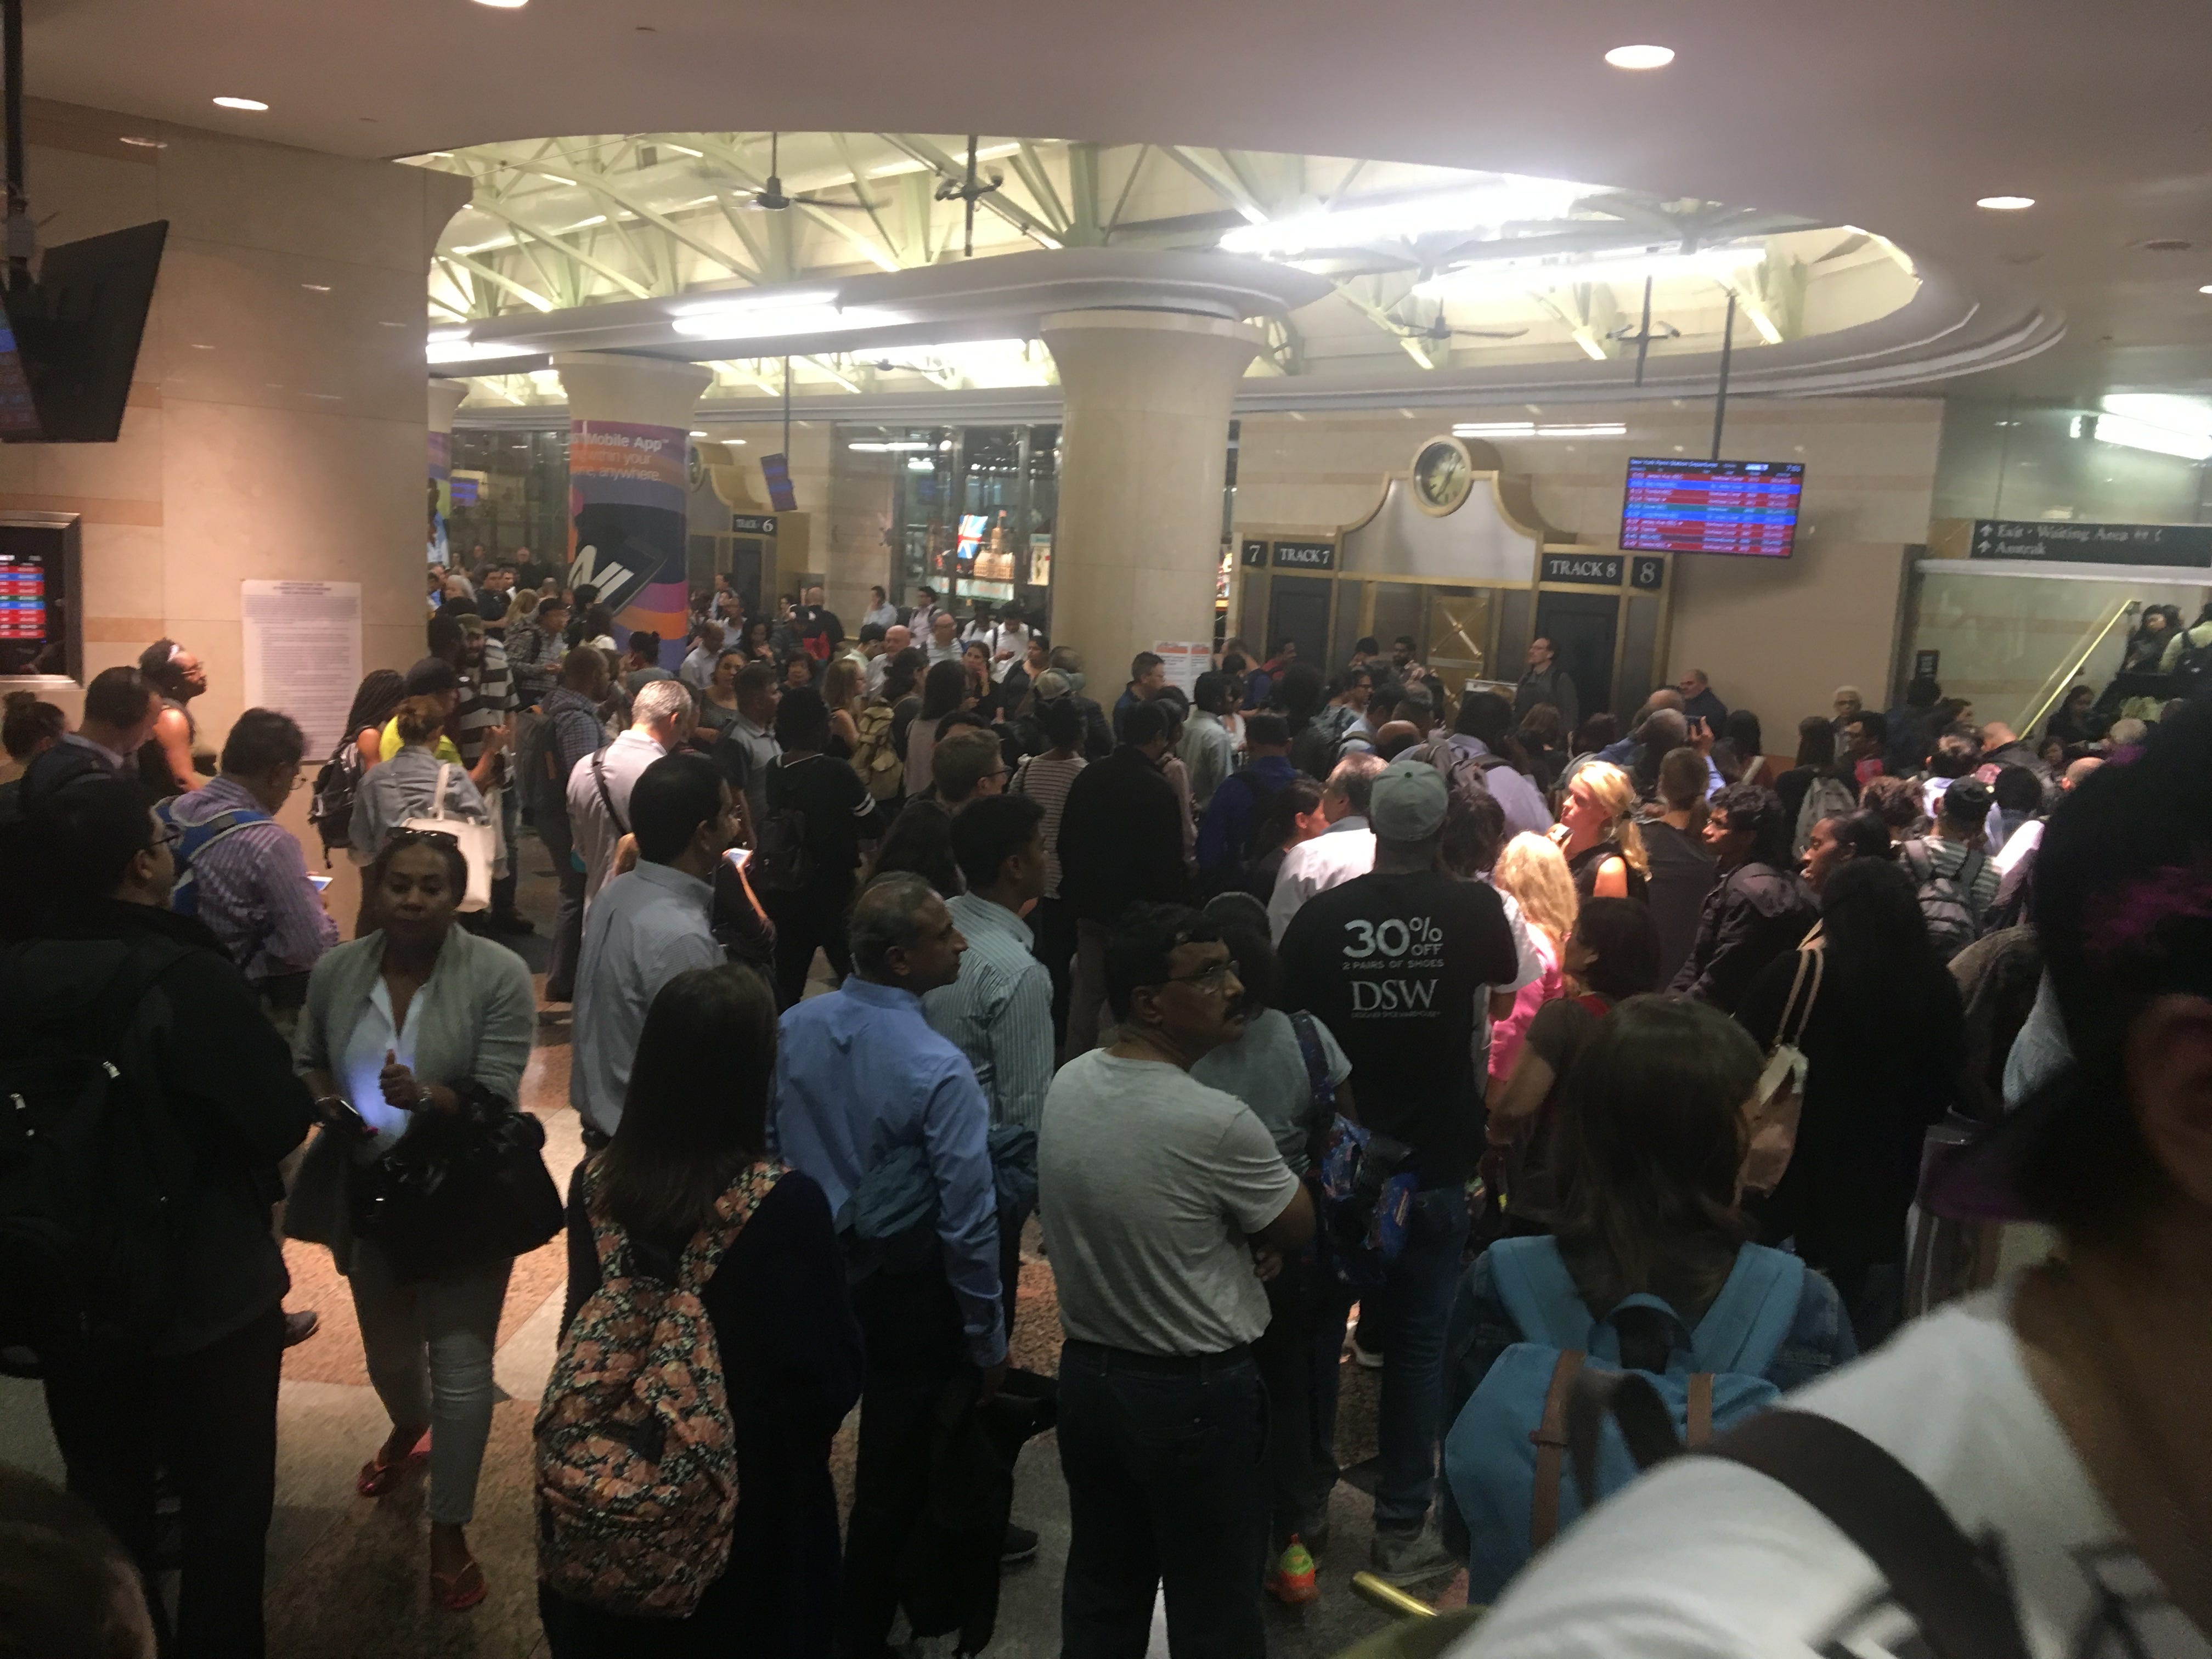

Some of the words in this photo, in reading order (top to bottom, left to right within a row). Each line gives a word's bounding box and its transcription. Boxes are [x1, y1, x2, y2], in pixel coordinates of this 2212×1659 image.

[588, 433, 630, 447] Mobile
[623, 454, 651, 465] your
[763, 518, 774, 532] 6
[1249, 544, 1261, 562] 7
[1280, 548, 1321, 562] TRACK
[1322, 550, 1330, 565] 7
[1549, 558, 1603, 577] TRACK
[1606, 562, 1617, 578] 8
[1640, 561, 1656, 584] 8
[1342, 916, 1443, 958] 30%
[1410, 943, 1444, 956] OFF
[1342, 961, 1351, 970] 2
[1352, 960, 1385, 970] PAIRS
[1388, 960, 1404, 969] OF
[1407, 958, 1444, 969] SHOES
[1349, 979, 1440, 1012] DSW
